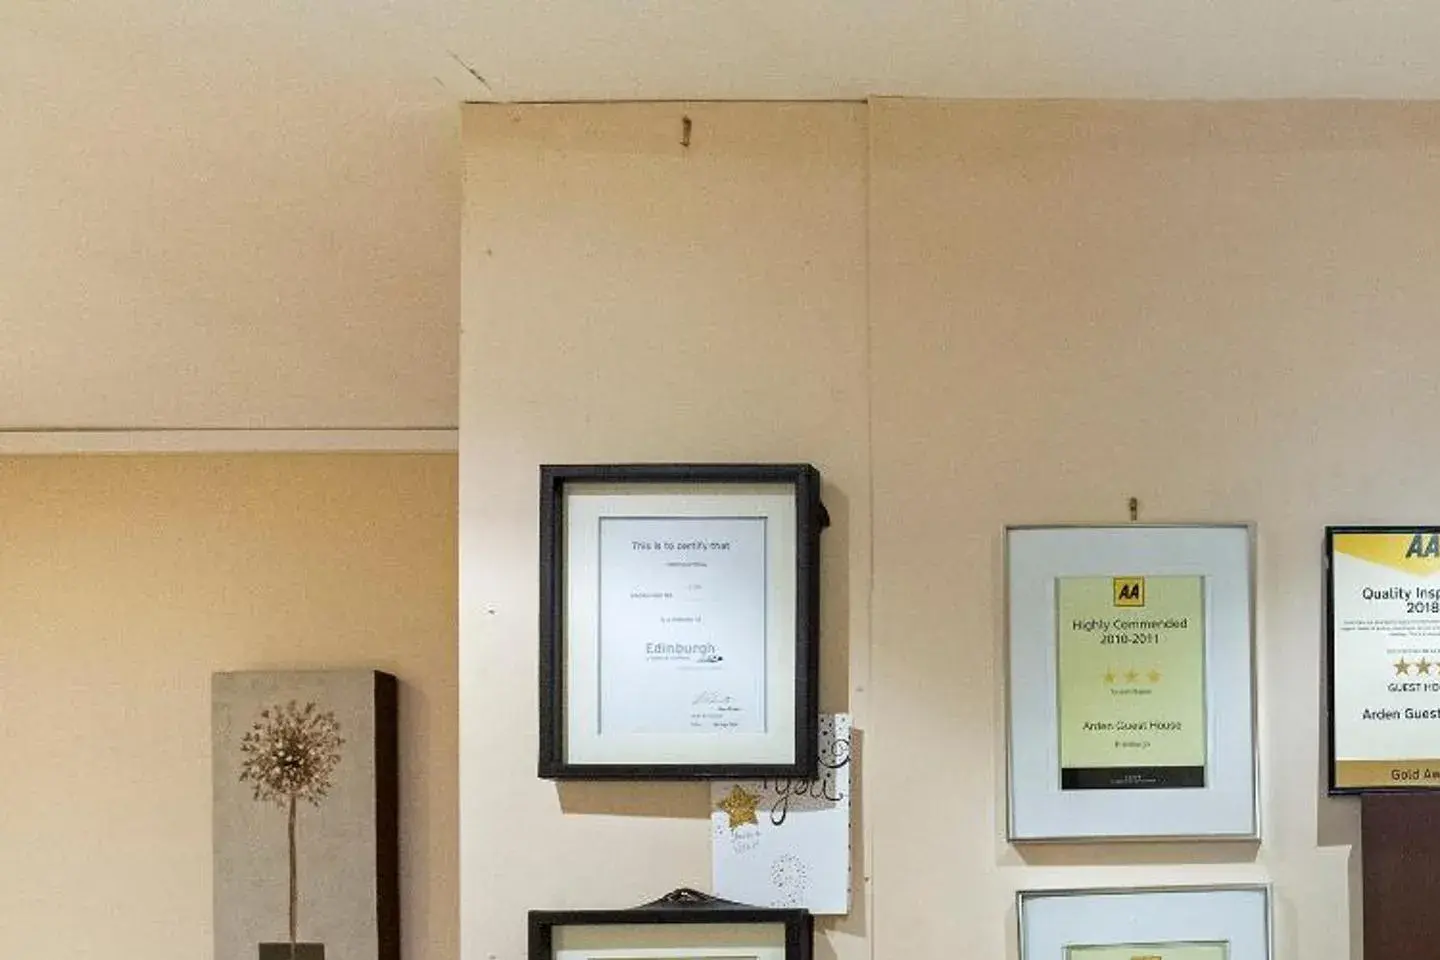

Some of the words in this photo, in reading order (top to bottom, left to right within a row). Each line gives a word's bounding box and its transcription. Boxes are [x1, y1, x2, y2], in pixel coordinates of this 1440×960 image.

[632, 541, 651, 550] This
[654, 541, 662, 550] is
[664, 541, 674, 550] to
[677, 540, 707, 552] certify
[710, 540, 730, 550] that
[1405, 534, 1440, 558] AA
[1119, 584, 1139, 600] AA
[1362, 586, 1411, 601] Quality
[1406, 602, 1440, 614] 2018
[1072, 619, 1110, 633] Highly
[1113, 617, 1188, 629] Commended
[1100, 633, 1159, 644] 2010-2011
[645, 642, 716, 656] Edinburgh
[1388, 683, 1420, 692] GUEST
[1362, 708, 1401, 720] Arden
[1391, 769, 1420, 780] Gold
